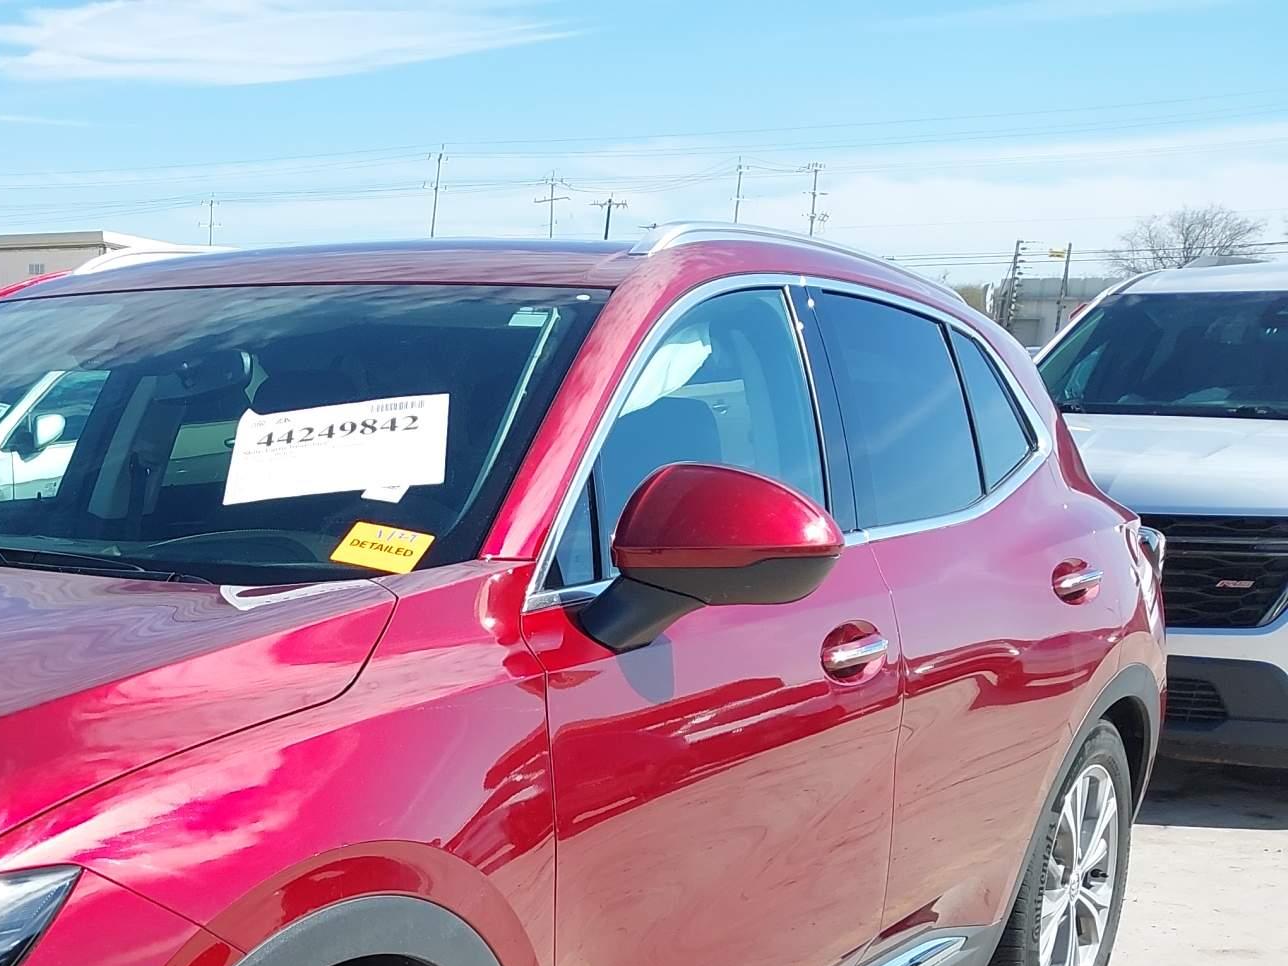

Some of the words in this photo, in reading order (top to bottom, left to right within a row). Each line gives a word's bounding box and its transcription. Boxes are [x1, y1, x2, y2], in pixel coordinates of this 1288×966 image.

[256, 415, 418, 447] 44249842
[349, 538, 414, 557] DETAILED
[1215, 579, 1255, 588] RS
